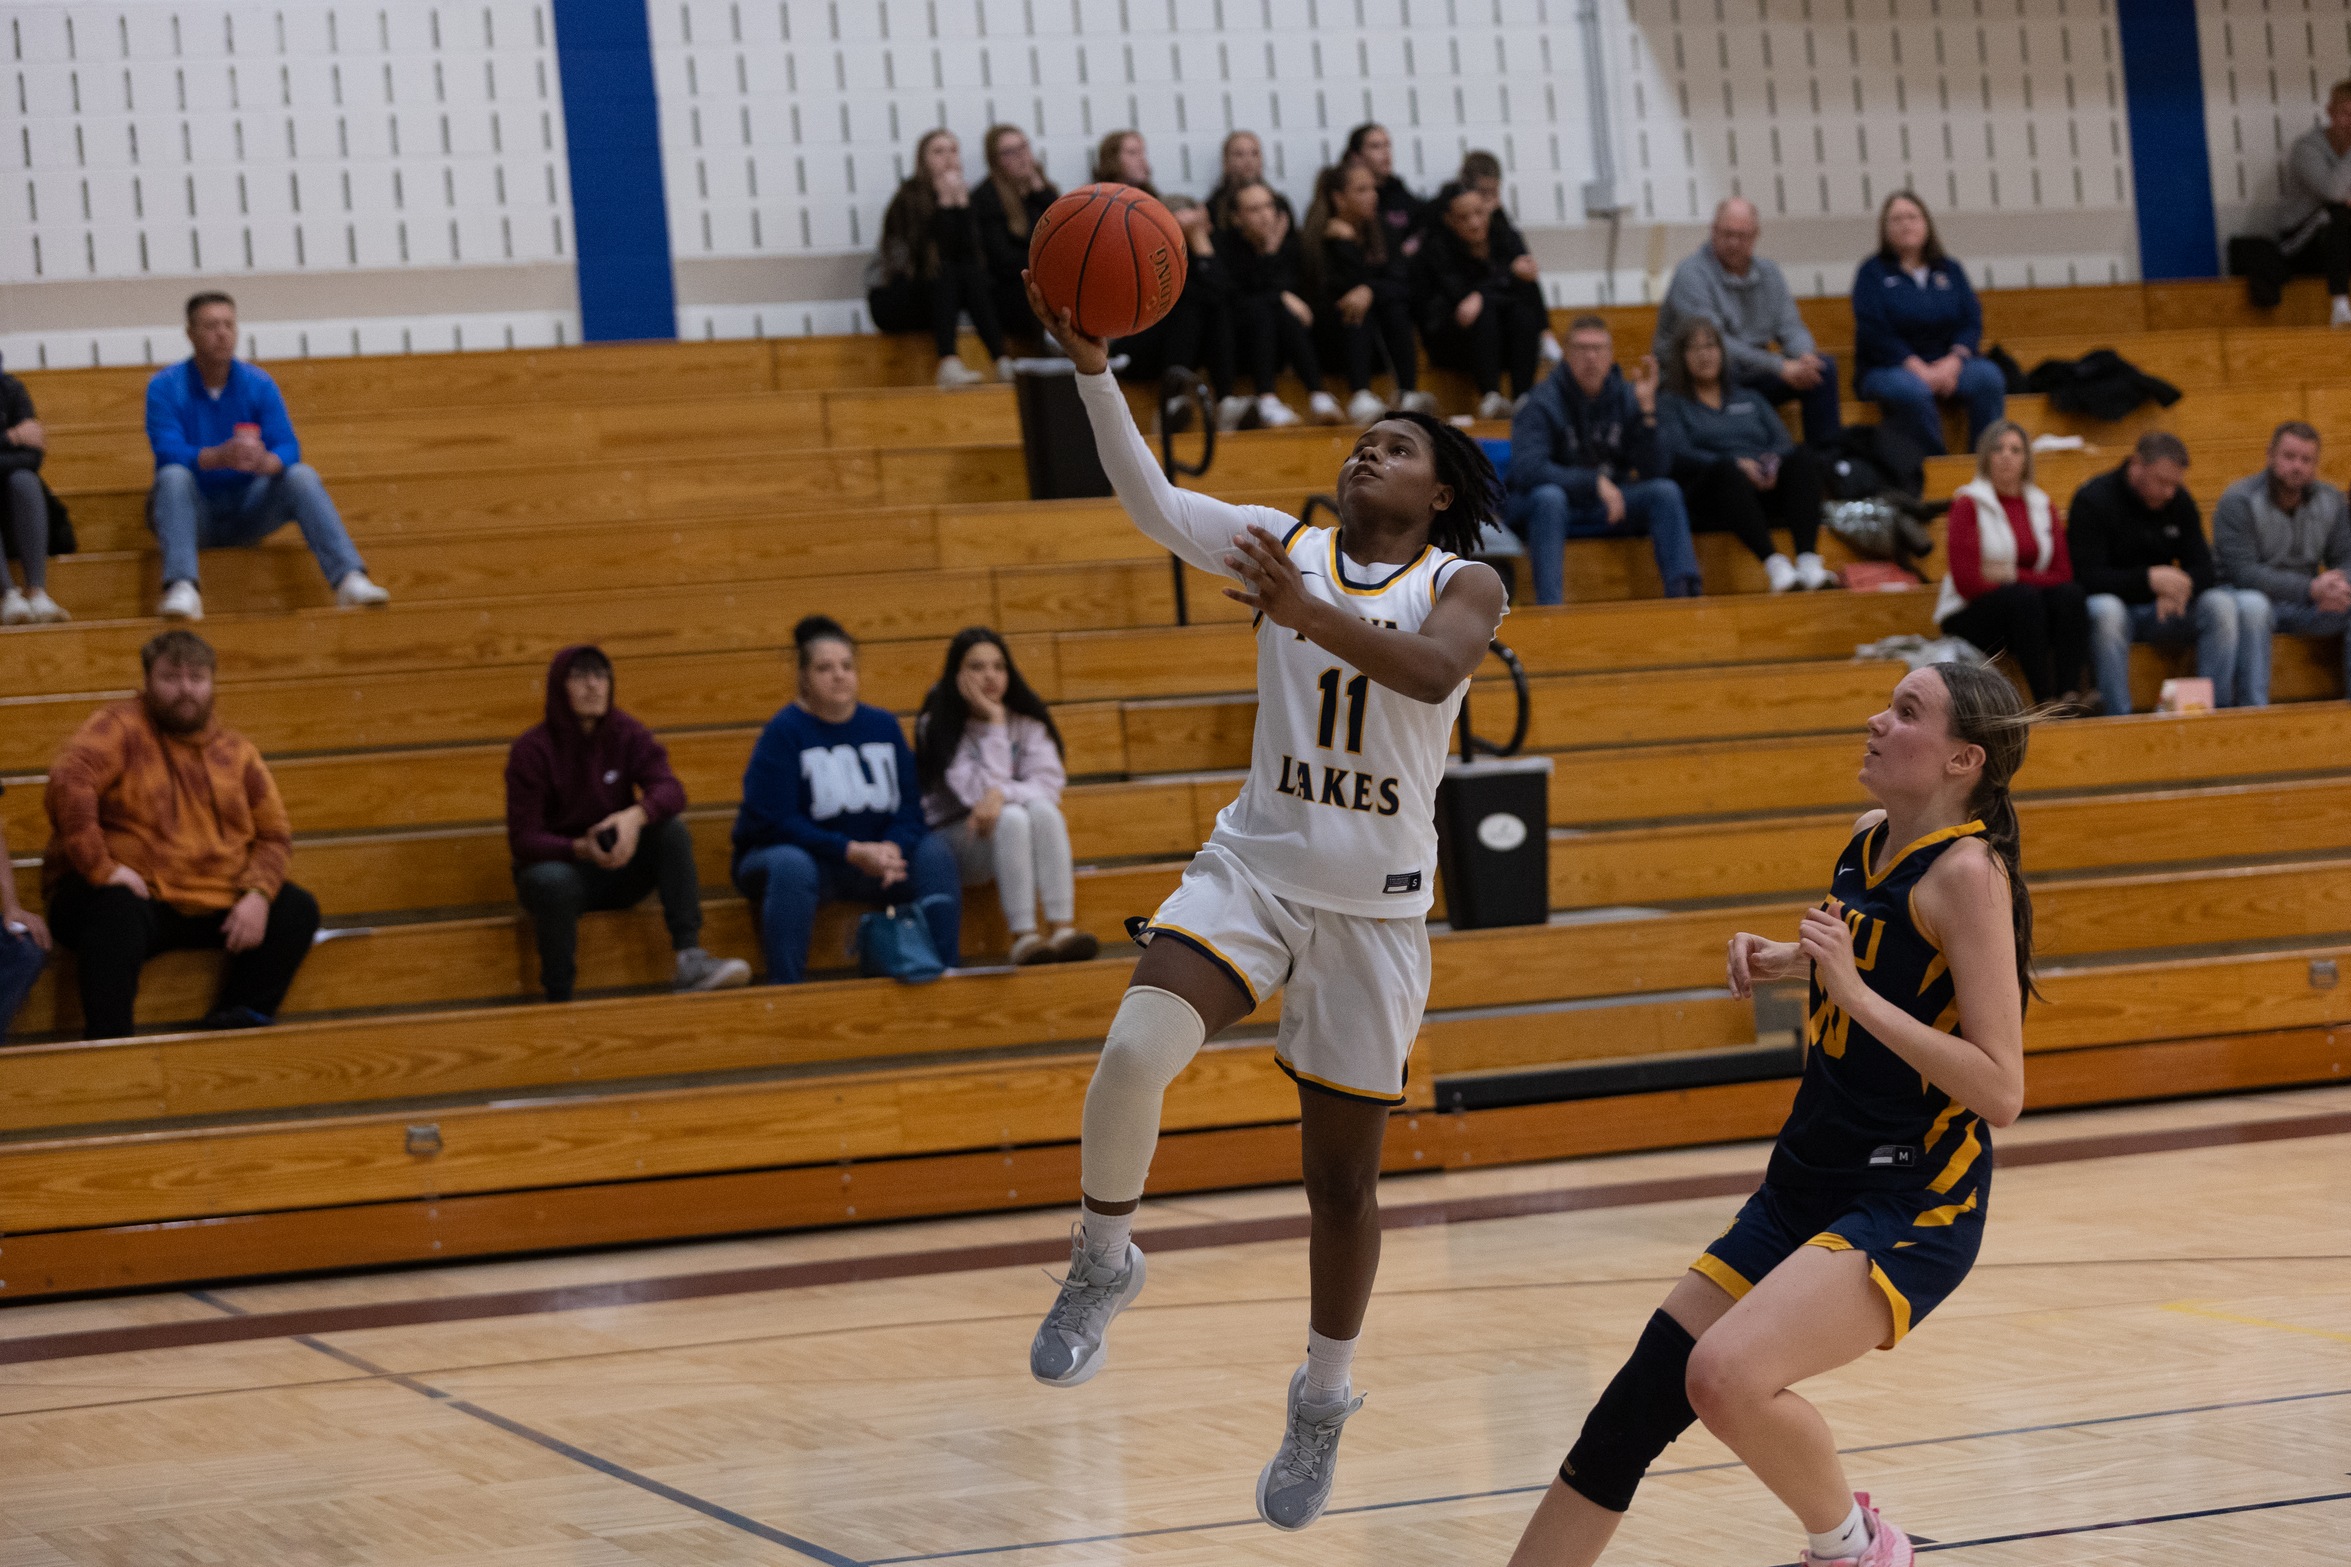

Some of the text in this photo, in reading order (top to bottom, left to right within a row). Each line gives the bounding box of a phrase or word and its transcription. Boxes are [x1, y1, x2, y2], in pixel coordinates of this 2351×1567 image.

[1316, 666, 1370, 756] 11
[1276, 755, 1400, 816] LAKES
[1412, 878, 1418, 887] S
[1899, 1151, 1909, 1161] M
